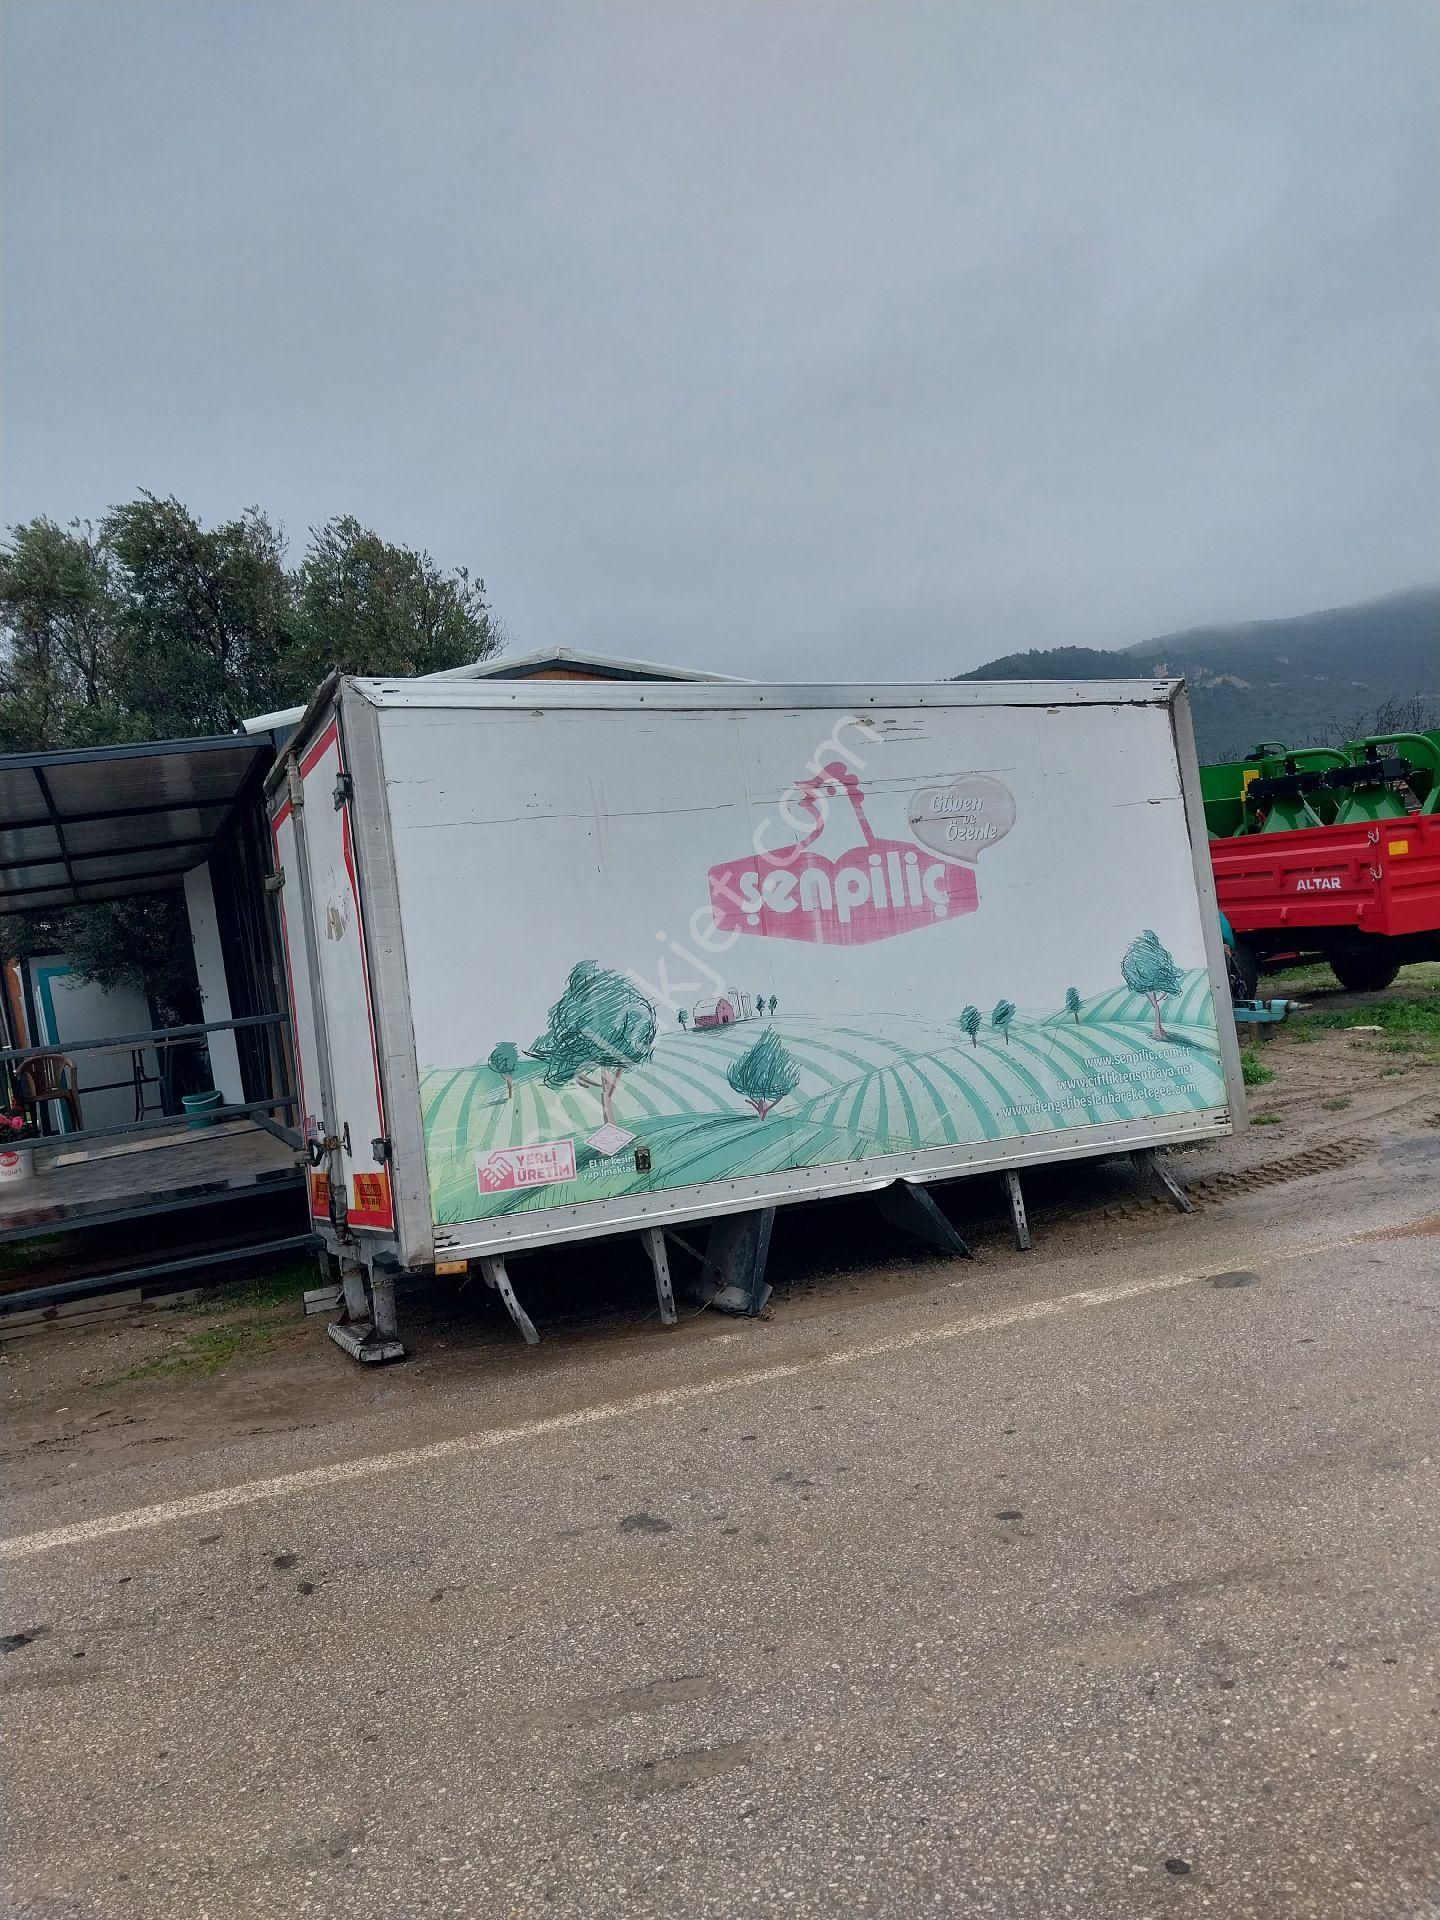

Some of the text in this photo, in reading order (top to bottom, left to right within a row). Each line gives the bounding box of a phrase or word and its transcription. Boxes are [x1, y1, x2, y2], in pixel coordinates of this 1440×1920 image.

[933, 795, 984, 814] Güven
[947, 820, 999, 842] Özenle
[739, 850, 950, 926] şenpiliç
[1296, 876, 1342, 891] ALTAR
[1084, 1046, 1191, 1068] www.senpilic.com.tr
[516, 1148, 558, 1167] YERLİ
[588, 1159, 597, 1169] El
[516, 1163, 570, 1183] ÜRETİM
[582, 1164, 637, 1181] yapılmaktad
